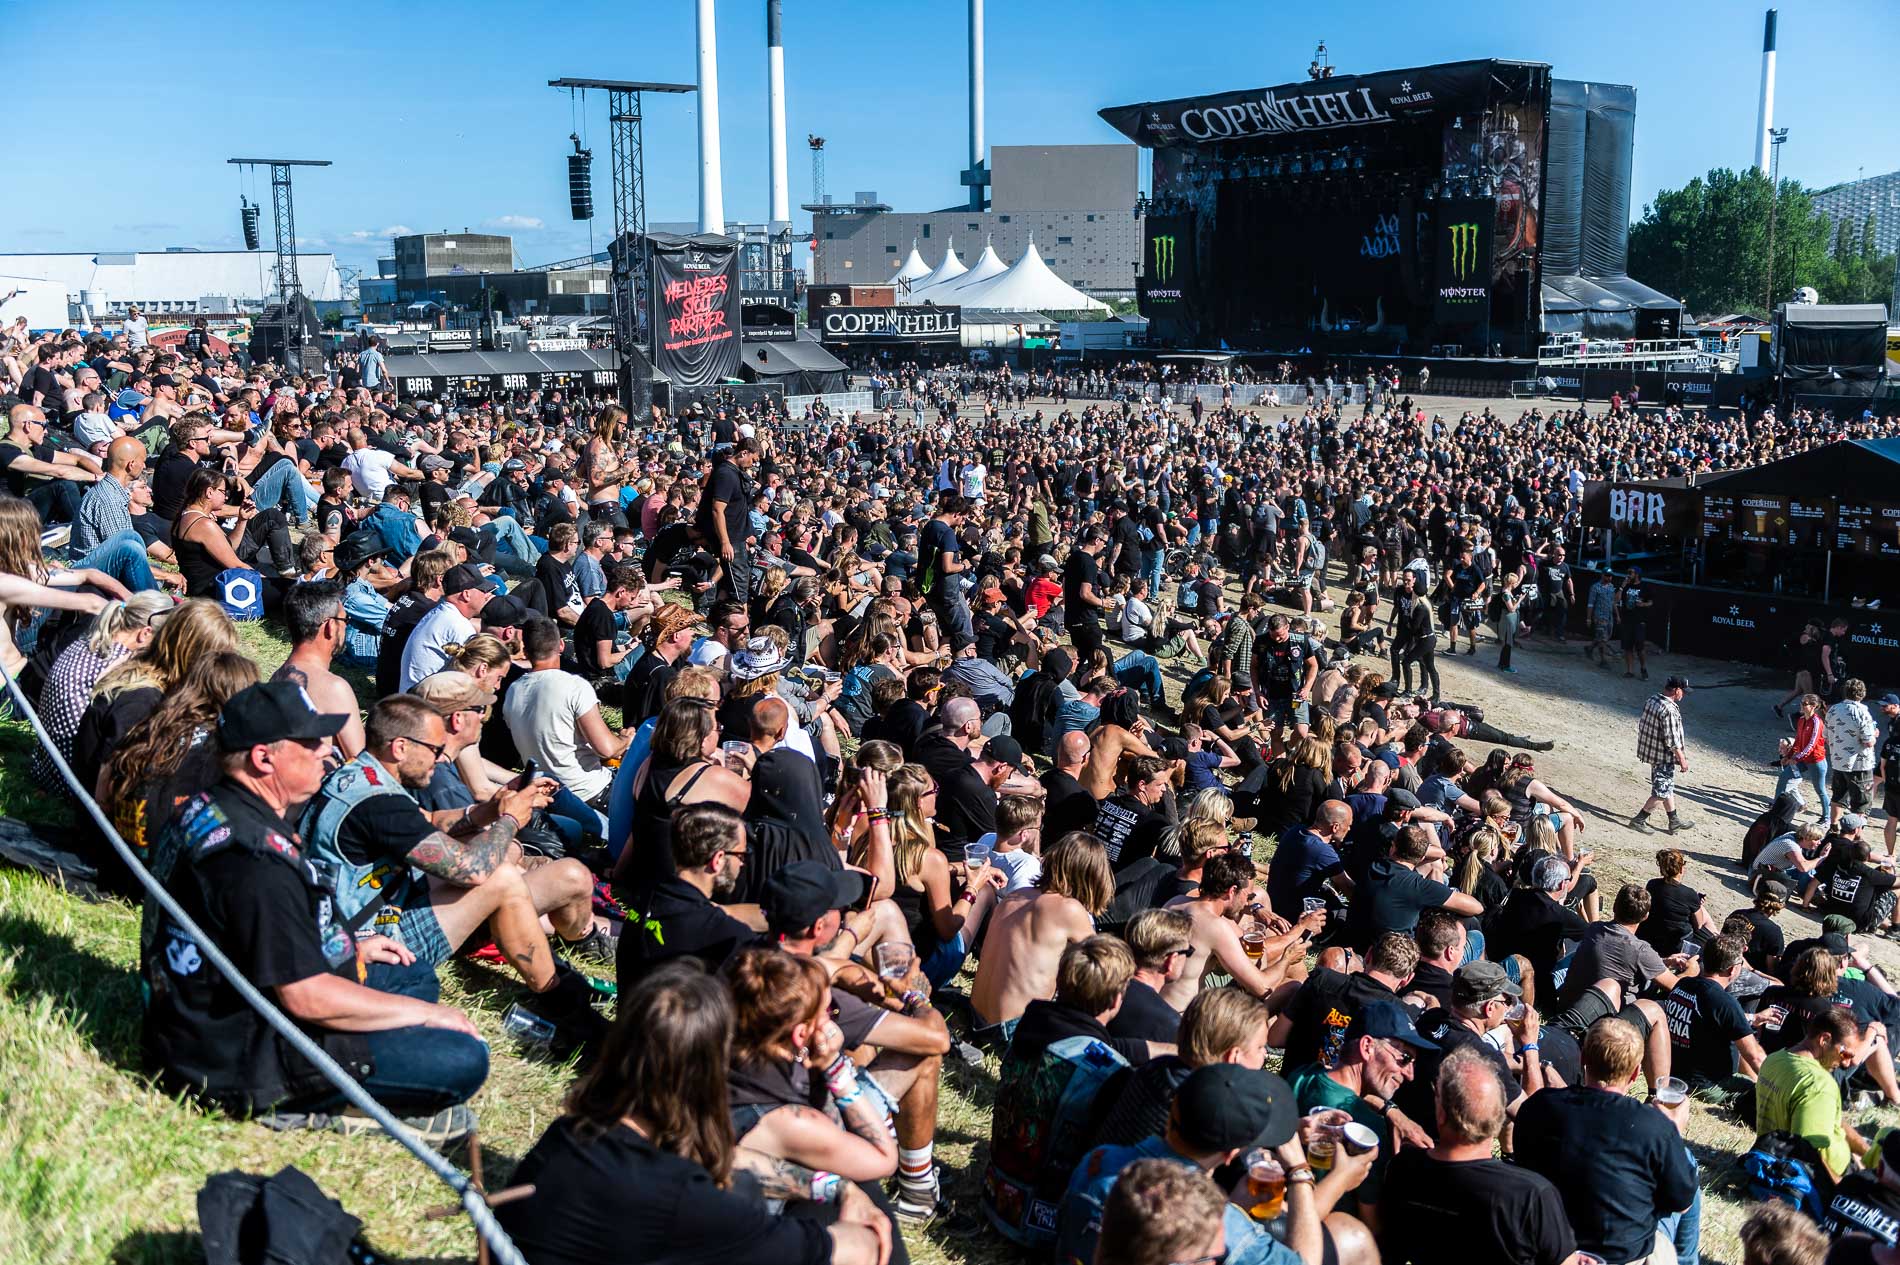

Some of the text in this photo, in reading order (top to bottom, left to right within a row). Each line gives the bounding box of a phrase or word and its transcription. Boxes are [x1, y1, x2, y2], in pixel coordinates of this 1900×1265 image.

[1390, 92, 1433, 105] ROYAL BEER
[1181, 89, 1391, 139] COPENHELL
[665, 274, 728, 304] HELVEDES
[1147, 289, 1182, 299] MONSTER
[1440, 287, 1486, 298] MONSTER
[668, 311, 727, 339] PARTNER
[825, 309, 960, 334] COPENHELL
[406, 377, 432, 394] BAR
[503, 374, 528, 390] BAR
[1610, 488, 1666, 527] BAR
[1741, 498, 1780, 508] COPENHELL
[1712, 615, 1755, 628] ROYAL BEER
[1851, 634, 1900, 648] ROYAL BEER
